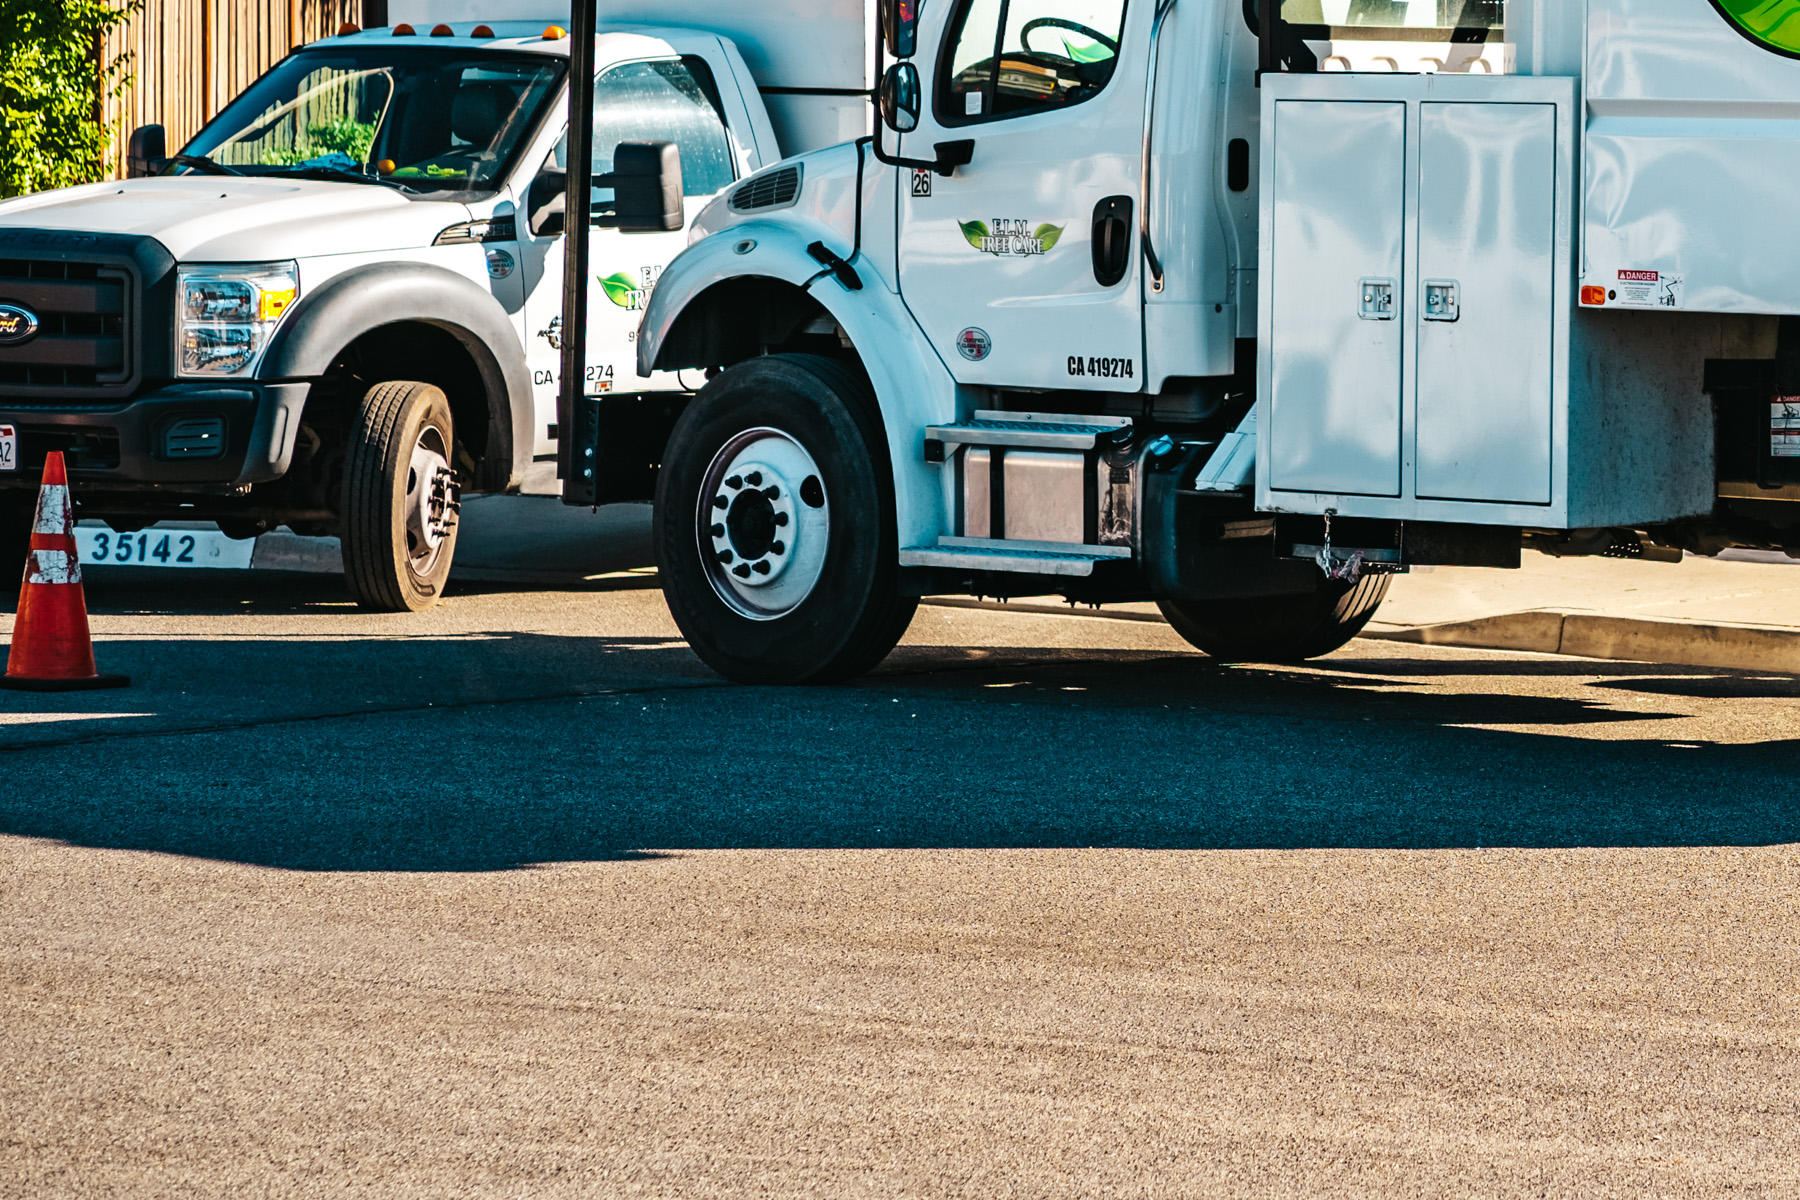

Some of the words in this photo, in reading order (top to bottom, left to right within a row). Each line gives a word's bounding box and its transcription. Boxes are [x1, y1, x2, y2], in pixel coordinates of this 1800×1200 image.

[913, 173, 929, 194] 26
[992, 218, 1031, 236] E.L.M.
[979, 236, 1010, 253] TREE
[1011, 236, 1045, 255] CARE
[1626, 272, 1656, 280] DANGER
[1067, 356, 1085, 376] CA
[1087, 357, 1133, 378] 419274
[534, 370, 553, 385] CA
[92, 532, 196, 563] 35142
